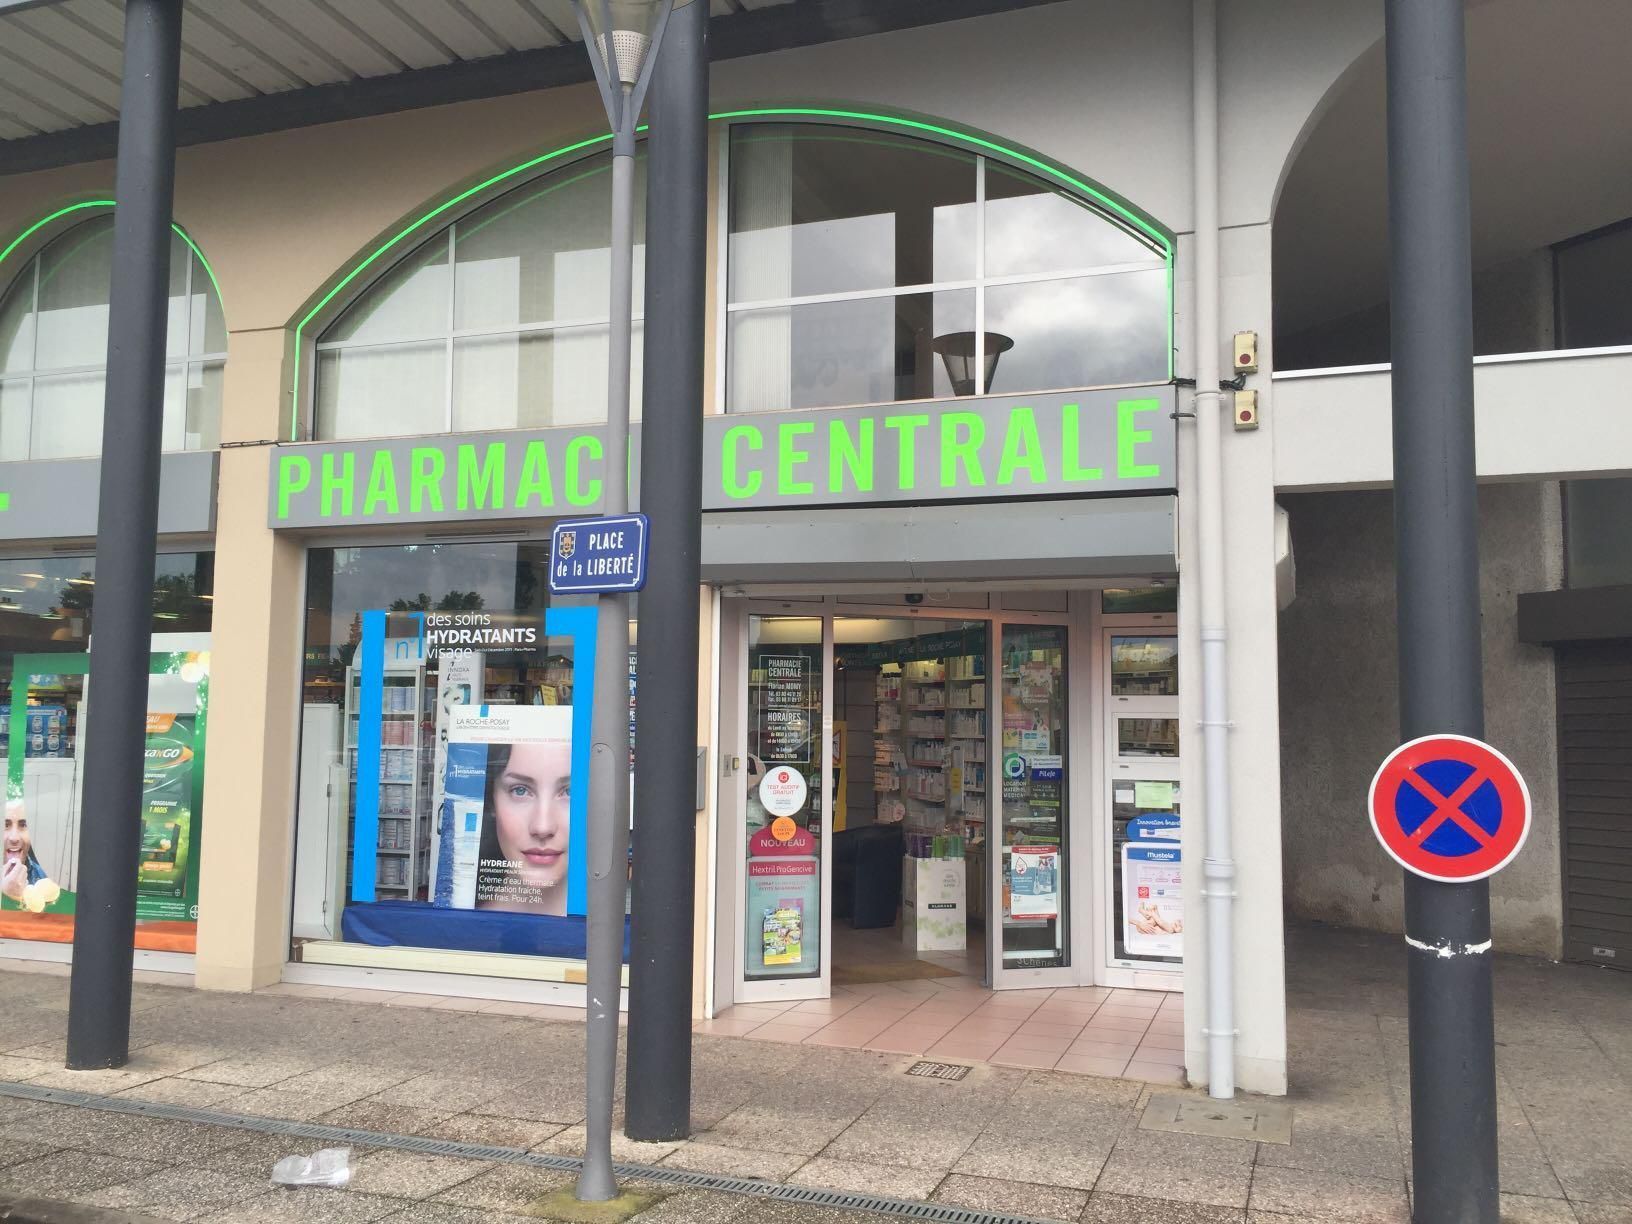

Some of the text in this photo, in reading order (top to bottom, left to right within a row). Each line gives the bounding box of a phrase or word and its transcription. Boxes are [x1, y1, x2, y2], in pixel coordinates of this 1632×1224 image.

[277, 398, 1160, 520] PHARMAC CENTRALE
[590, 532, 624, 550] PLACE
[557, 553, 634, 576] de la LIBERTÉ
[426, 612, 491, 626] des soins
[426, 628, 536, 644] HYDRATANTS
[427, 644, 473, 662] visage
[769, 659, 801, 668] PHARMACIE
[769, 668, 801, 678] CENTRALE
[768, 712, 801, 721] HORAIRES
[760, 839, 806, 847] NOUVEAU
[480, 859, 523, 868] HYDREANE
[479, 875, 502, 883] Crème
[478, 884, 517, 893] Hydratation
[511, 895, 528, 903] Pour
